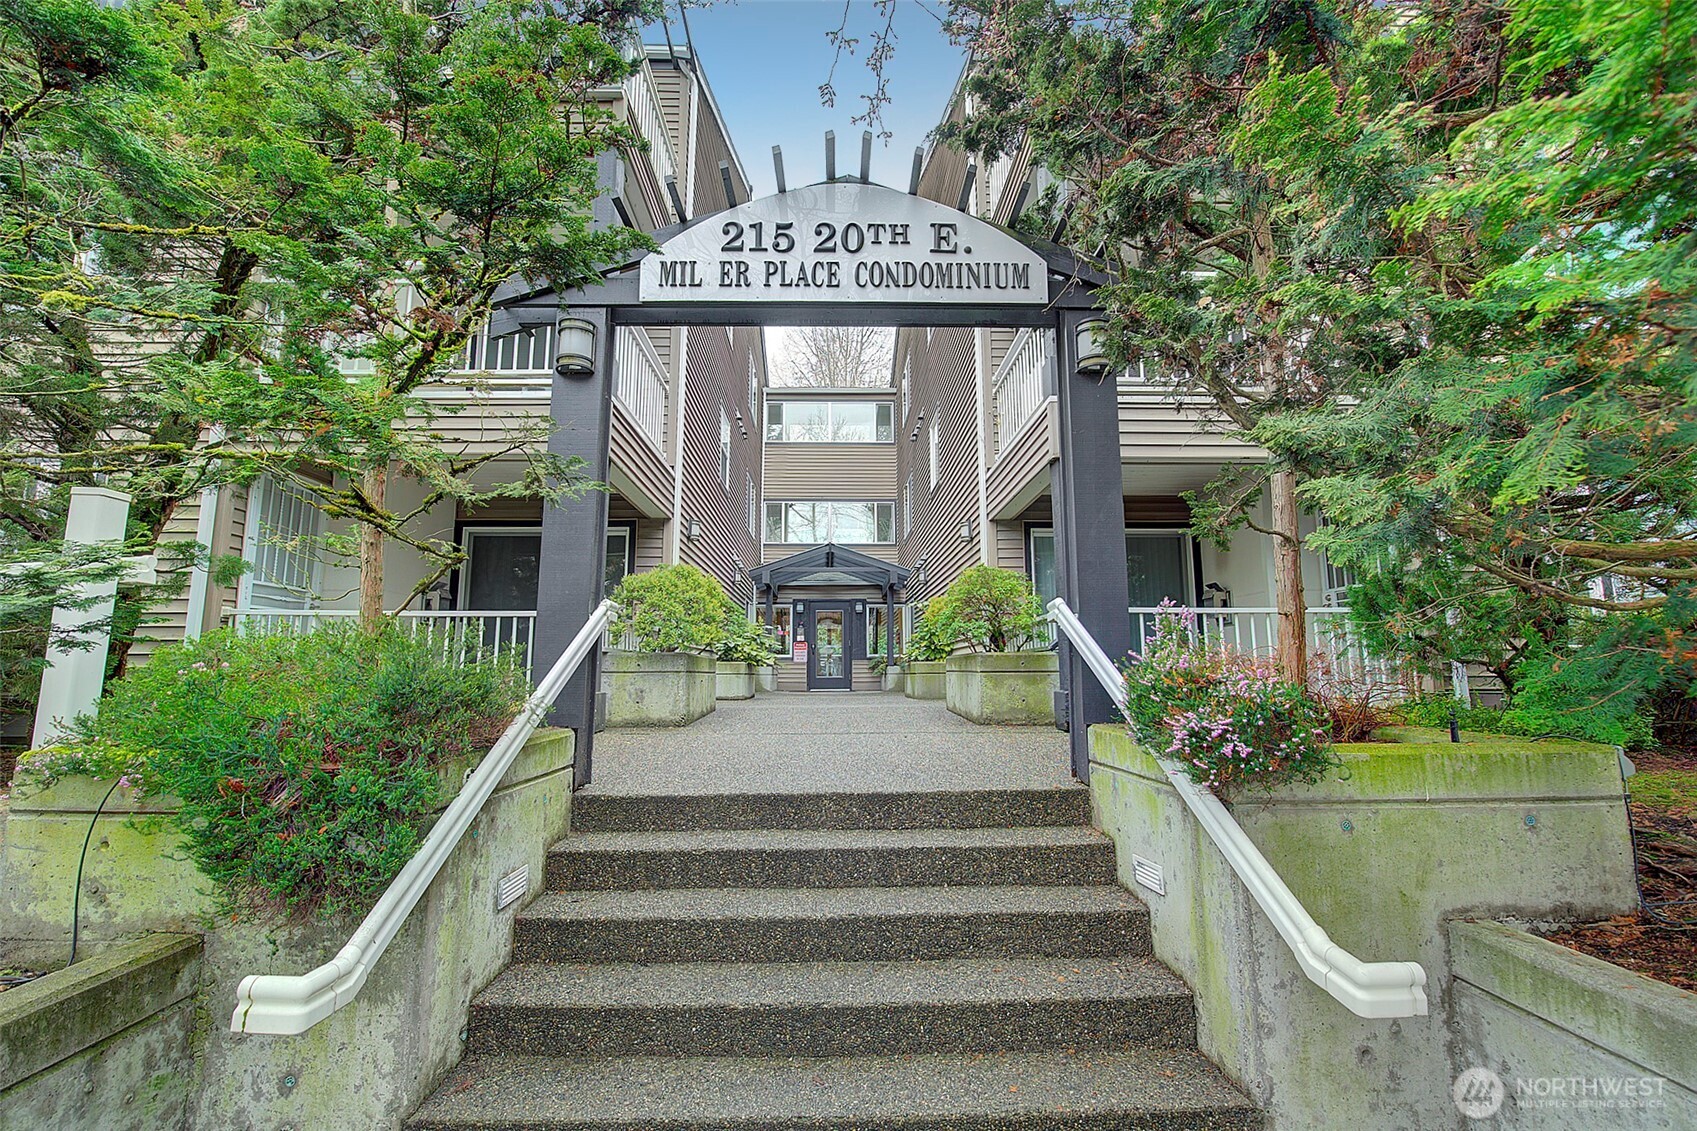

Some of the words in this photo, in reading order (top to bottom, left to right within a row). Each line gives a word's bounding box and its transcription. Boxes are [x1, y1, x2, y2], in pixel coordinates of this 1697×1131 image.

[721, 221, 796, 253] 215
[813, 222, 911, 254] 20TH
[929, 223, 973, 254] E.
[763, 261, 841, 288] PLACE
[854, 261, 1031, 290] CONDOMINIUM
